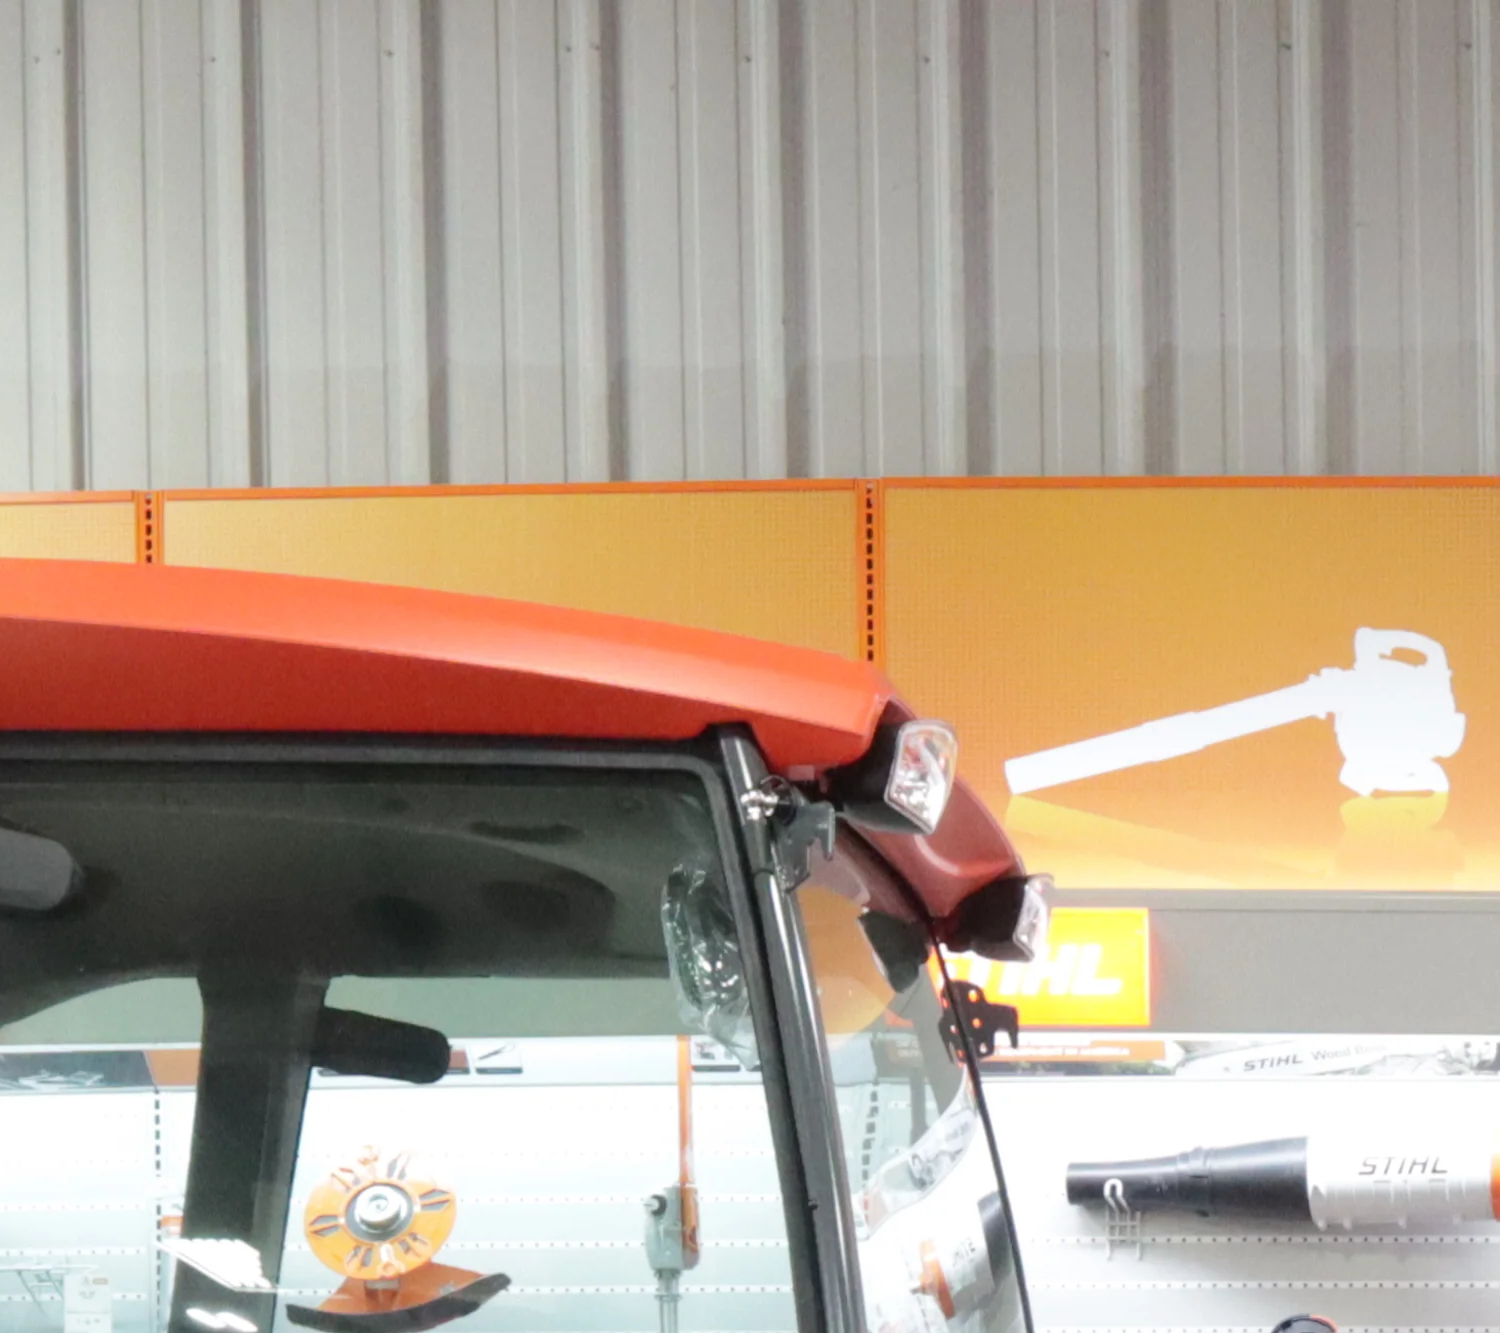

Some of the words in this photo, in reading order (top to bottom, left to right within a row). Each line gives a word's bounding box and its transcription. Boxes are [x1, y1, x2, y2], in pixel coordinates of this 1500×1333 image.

[1243, 1054, 1304, 1072] STIHL
[1311, 1045, 1352, 1062] Wood
[1358, 1156, 1448, 1176] STIHL
